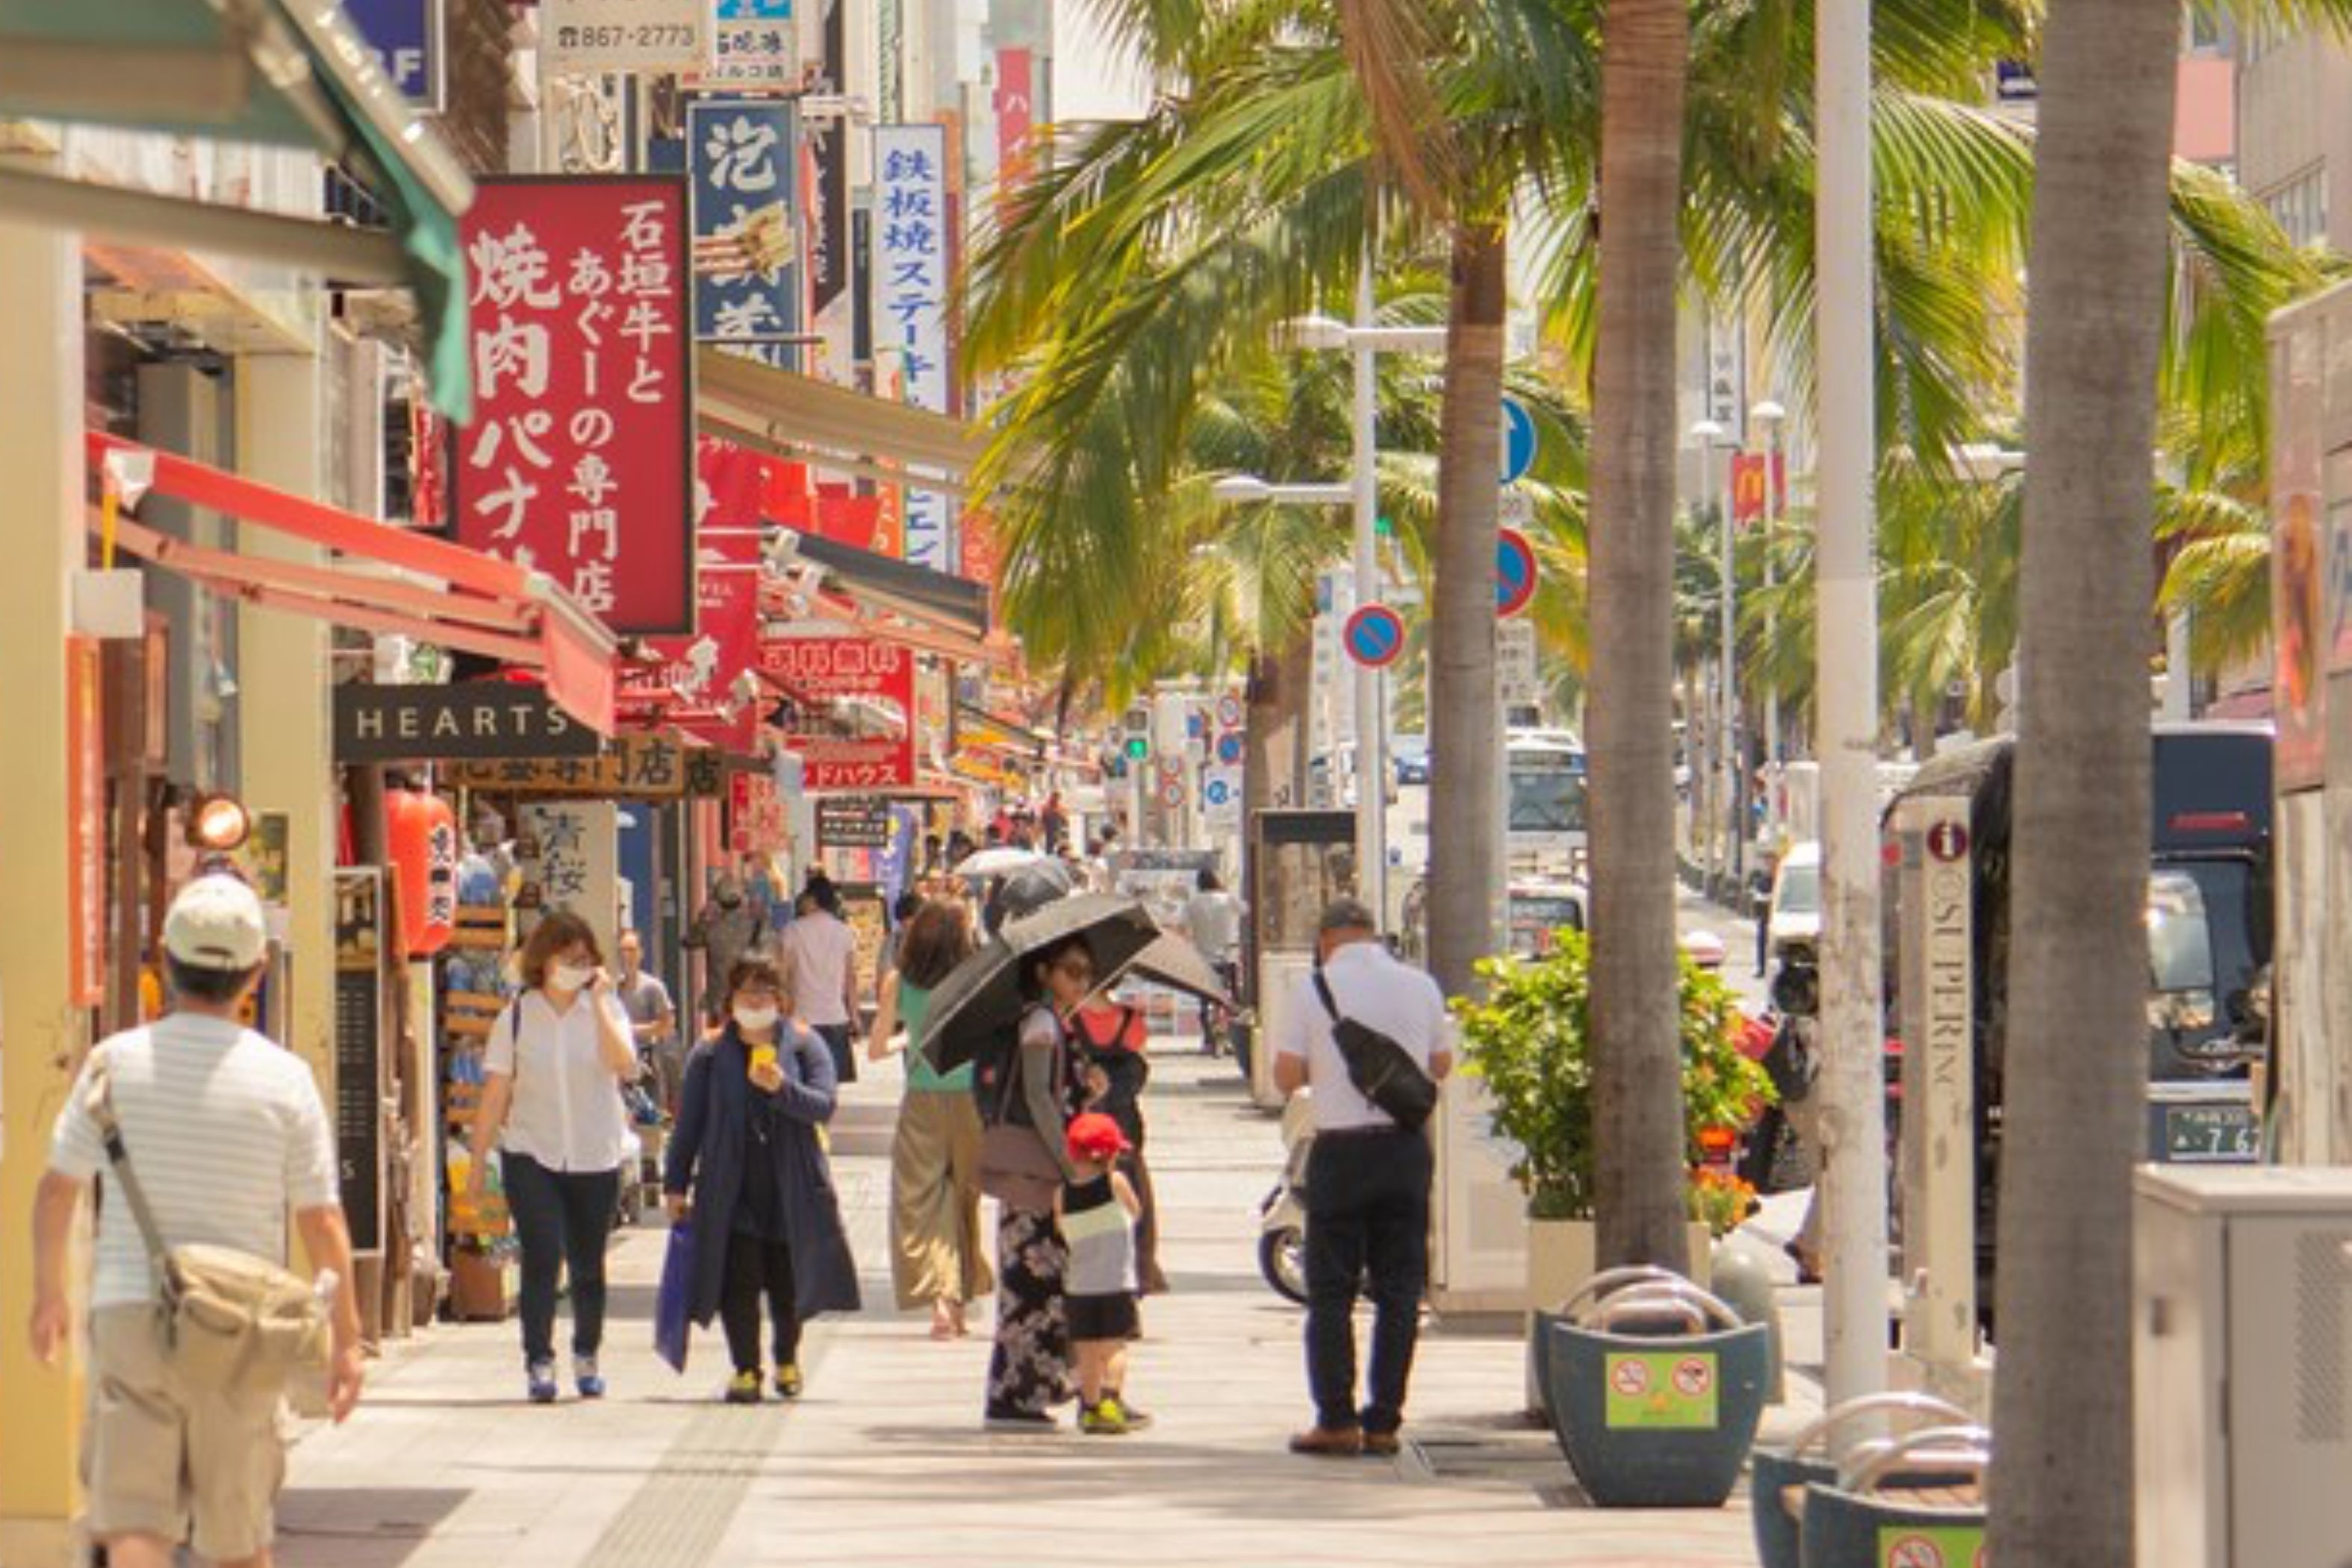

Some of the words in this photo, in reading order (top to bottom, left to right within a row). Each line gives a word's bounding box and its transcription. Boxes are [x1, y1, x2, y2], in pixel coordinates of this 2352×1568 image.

[468, 222, 561, 567] 焼肉パナ
[617, 199, 672, 403] 石垣牛と
[566, 247, 618, 612] あぐーの専門店
[356, 702, 568, 739] HEARTS
[806, 763, 898, 785] ドハウス
